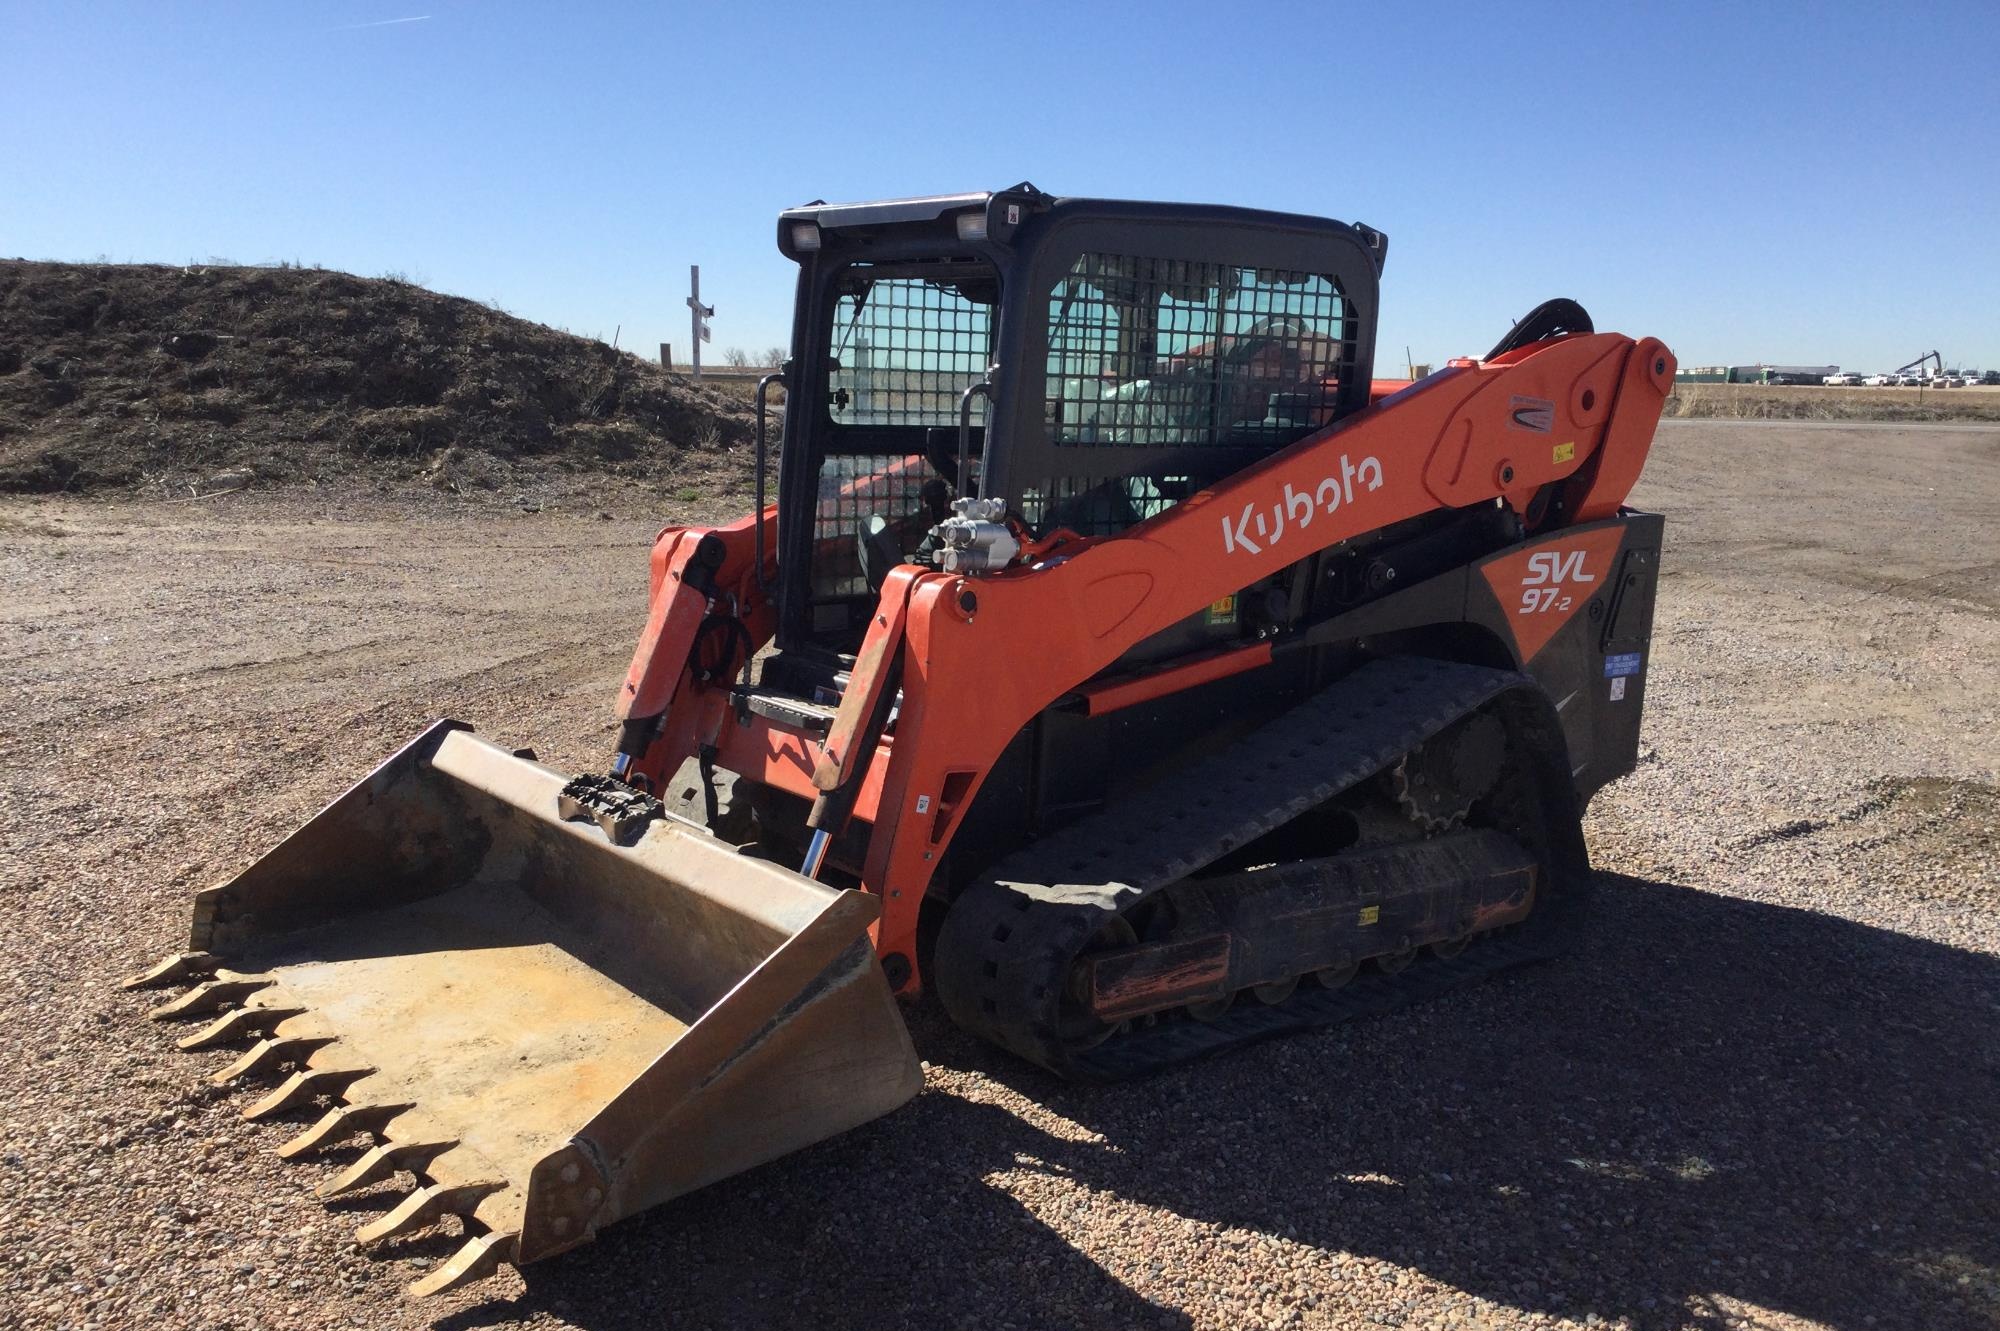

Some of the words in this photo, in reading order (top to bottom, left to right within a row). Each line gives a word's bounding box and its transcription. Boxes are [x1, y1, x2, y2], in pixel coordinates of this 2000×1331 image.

[1221, 454, 1384, 555] Kubota
[1521, 550, 1595, 586] SVL
[1518, 587, 1572, 615] 97-2
